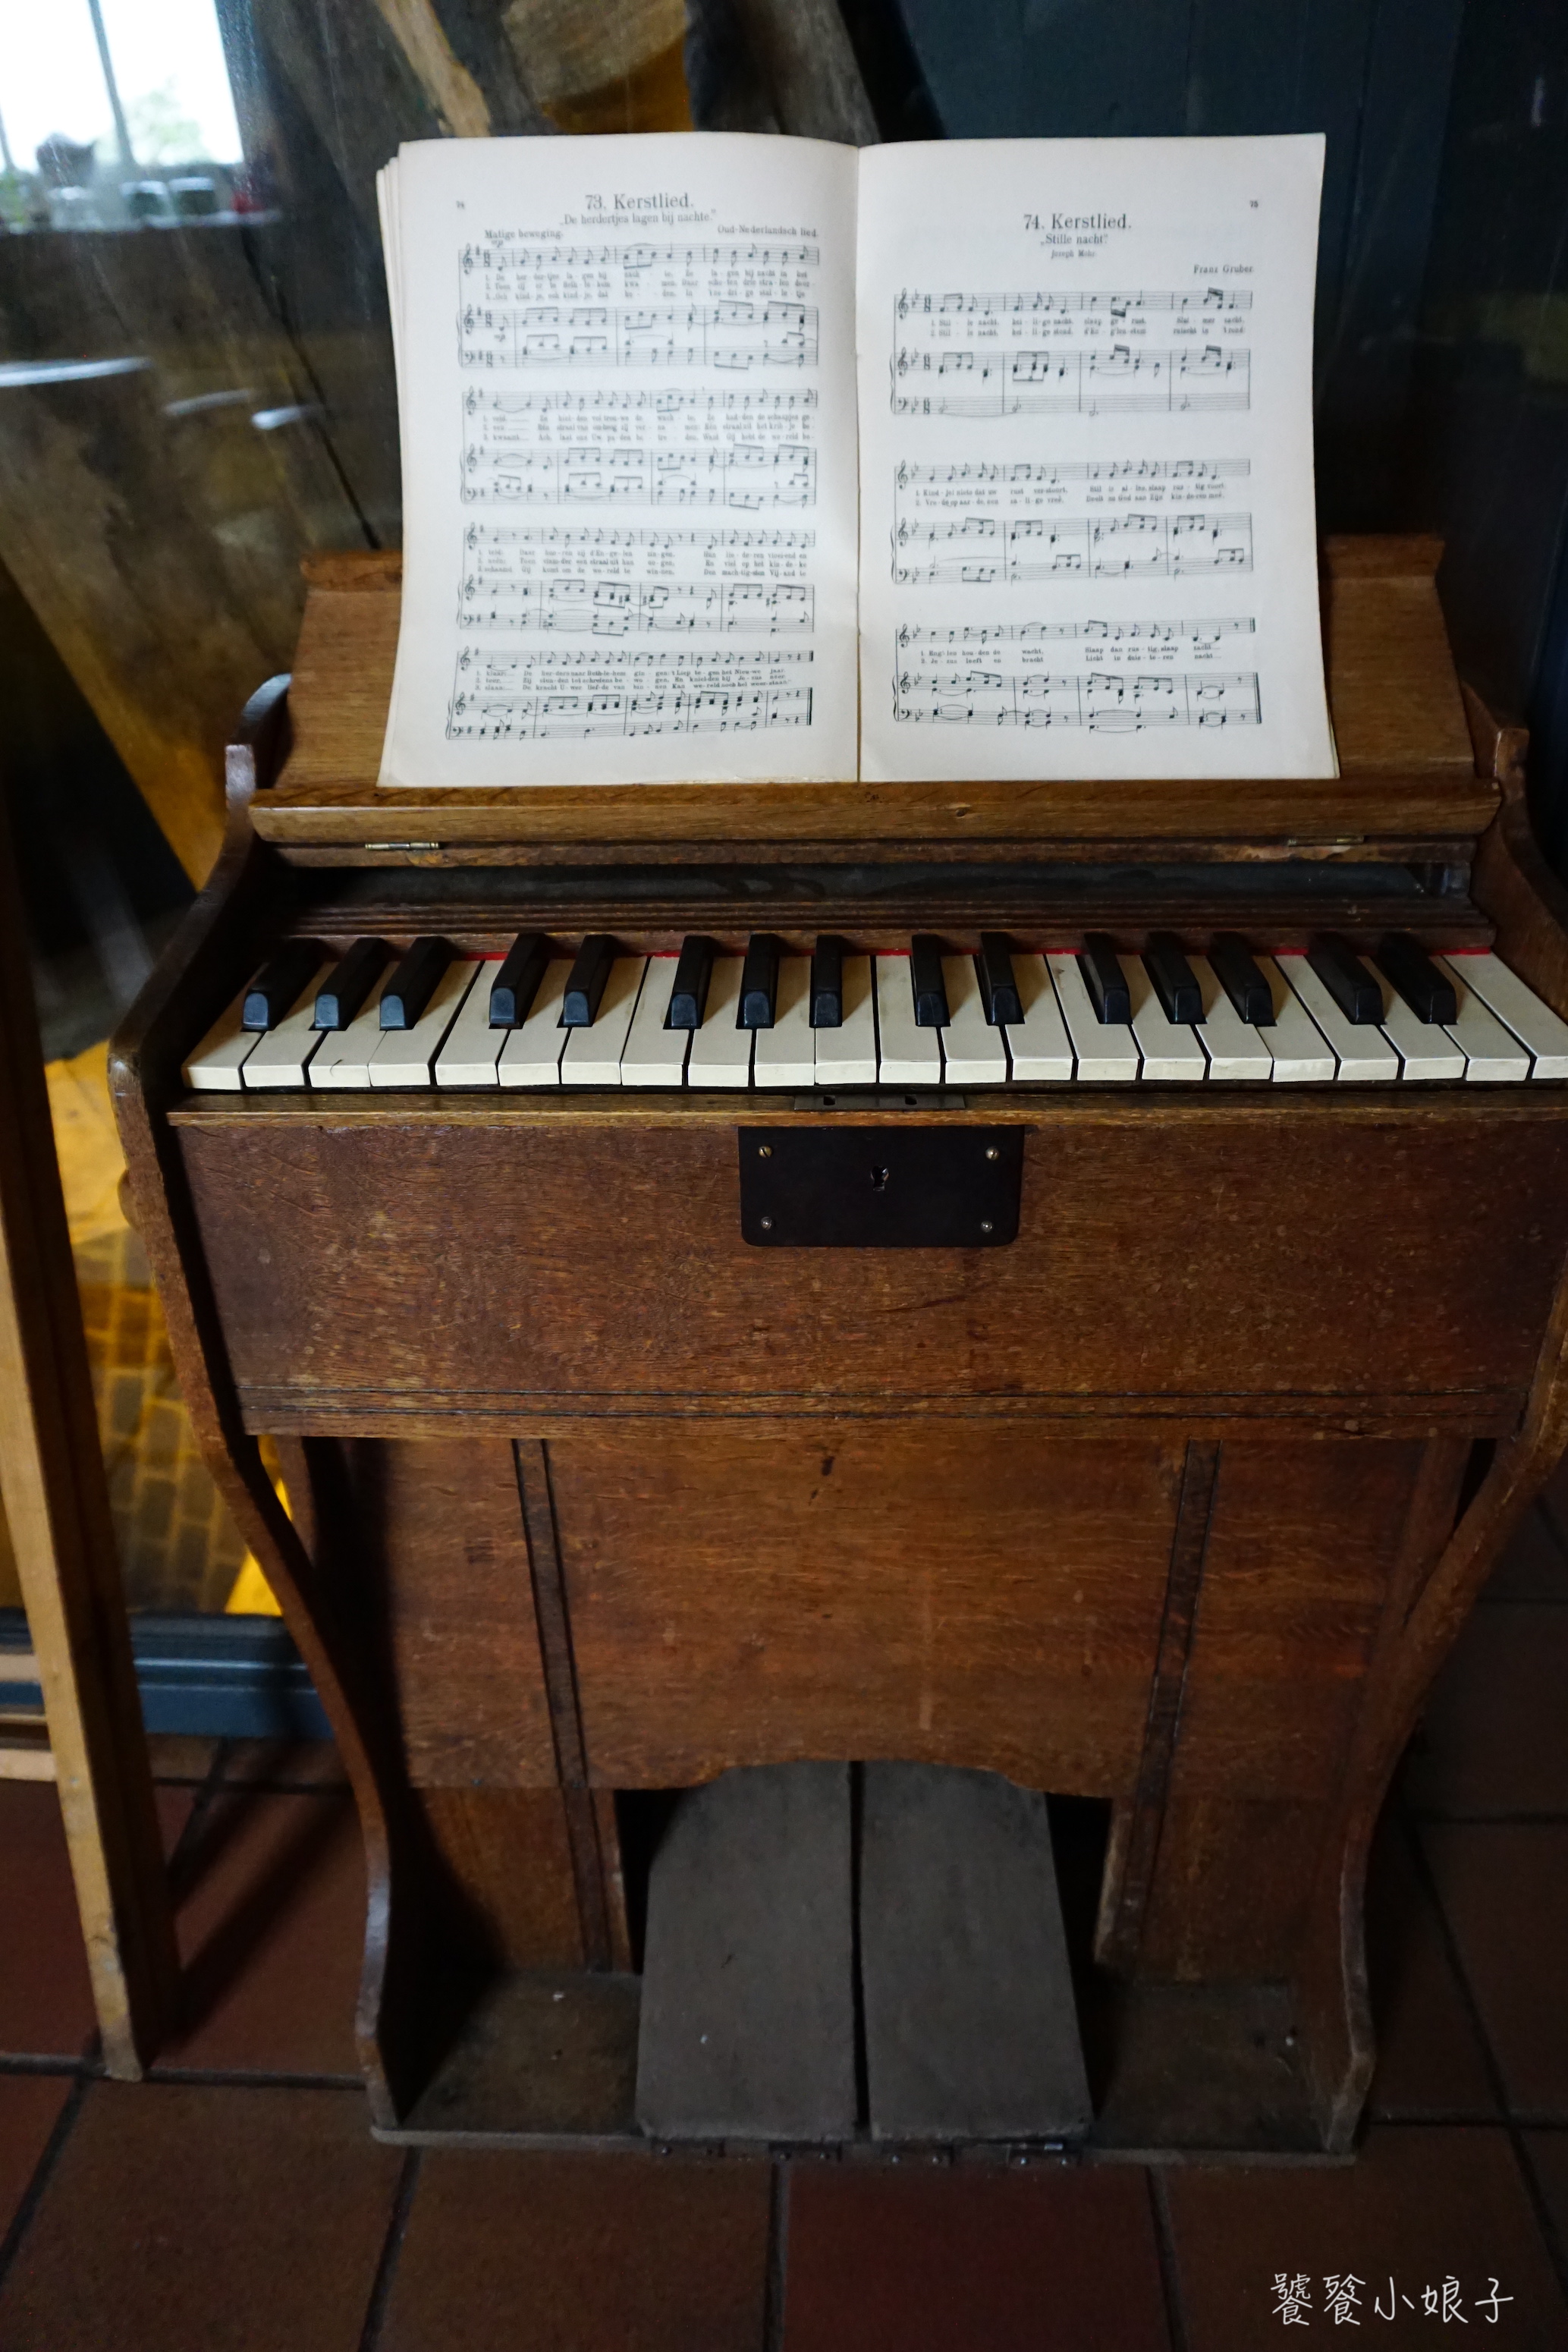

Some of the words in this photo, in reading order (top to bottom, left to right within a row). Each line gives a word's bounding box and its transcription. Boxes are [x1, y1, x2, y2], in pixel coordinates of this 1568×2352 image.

[585, 193, 607, 210] 73.
[614, 192, 694, 210] Kerstlied.
[581, 212, 629, 227] herdertjes
[633, 212, 658, 226] lagen
[662, 211, 674, 225] bij
[1023, 213, 1045, 230] 74.
[1051, 212, 1133, 230] Kerstlied.
[1193, 263, 1218, 274] Franz
